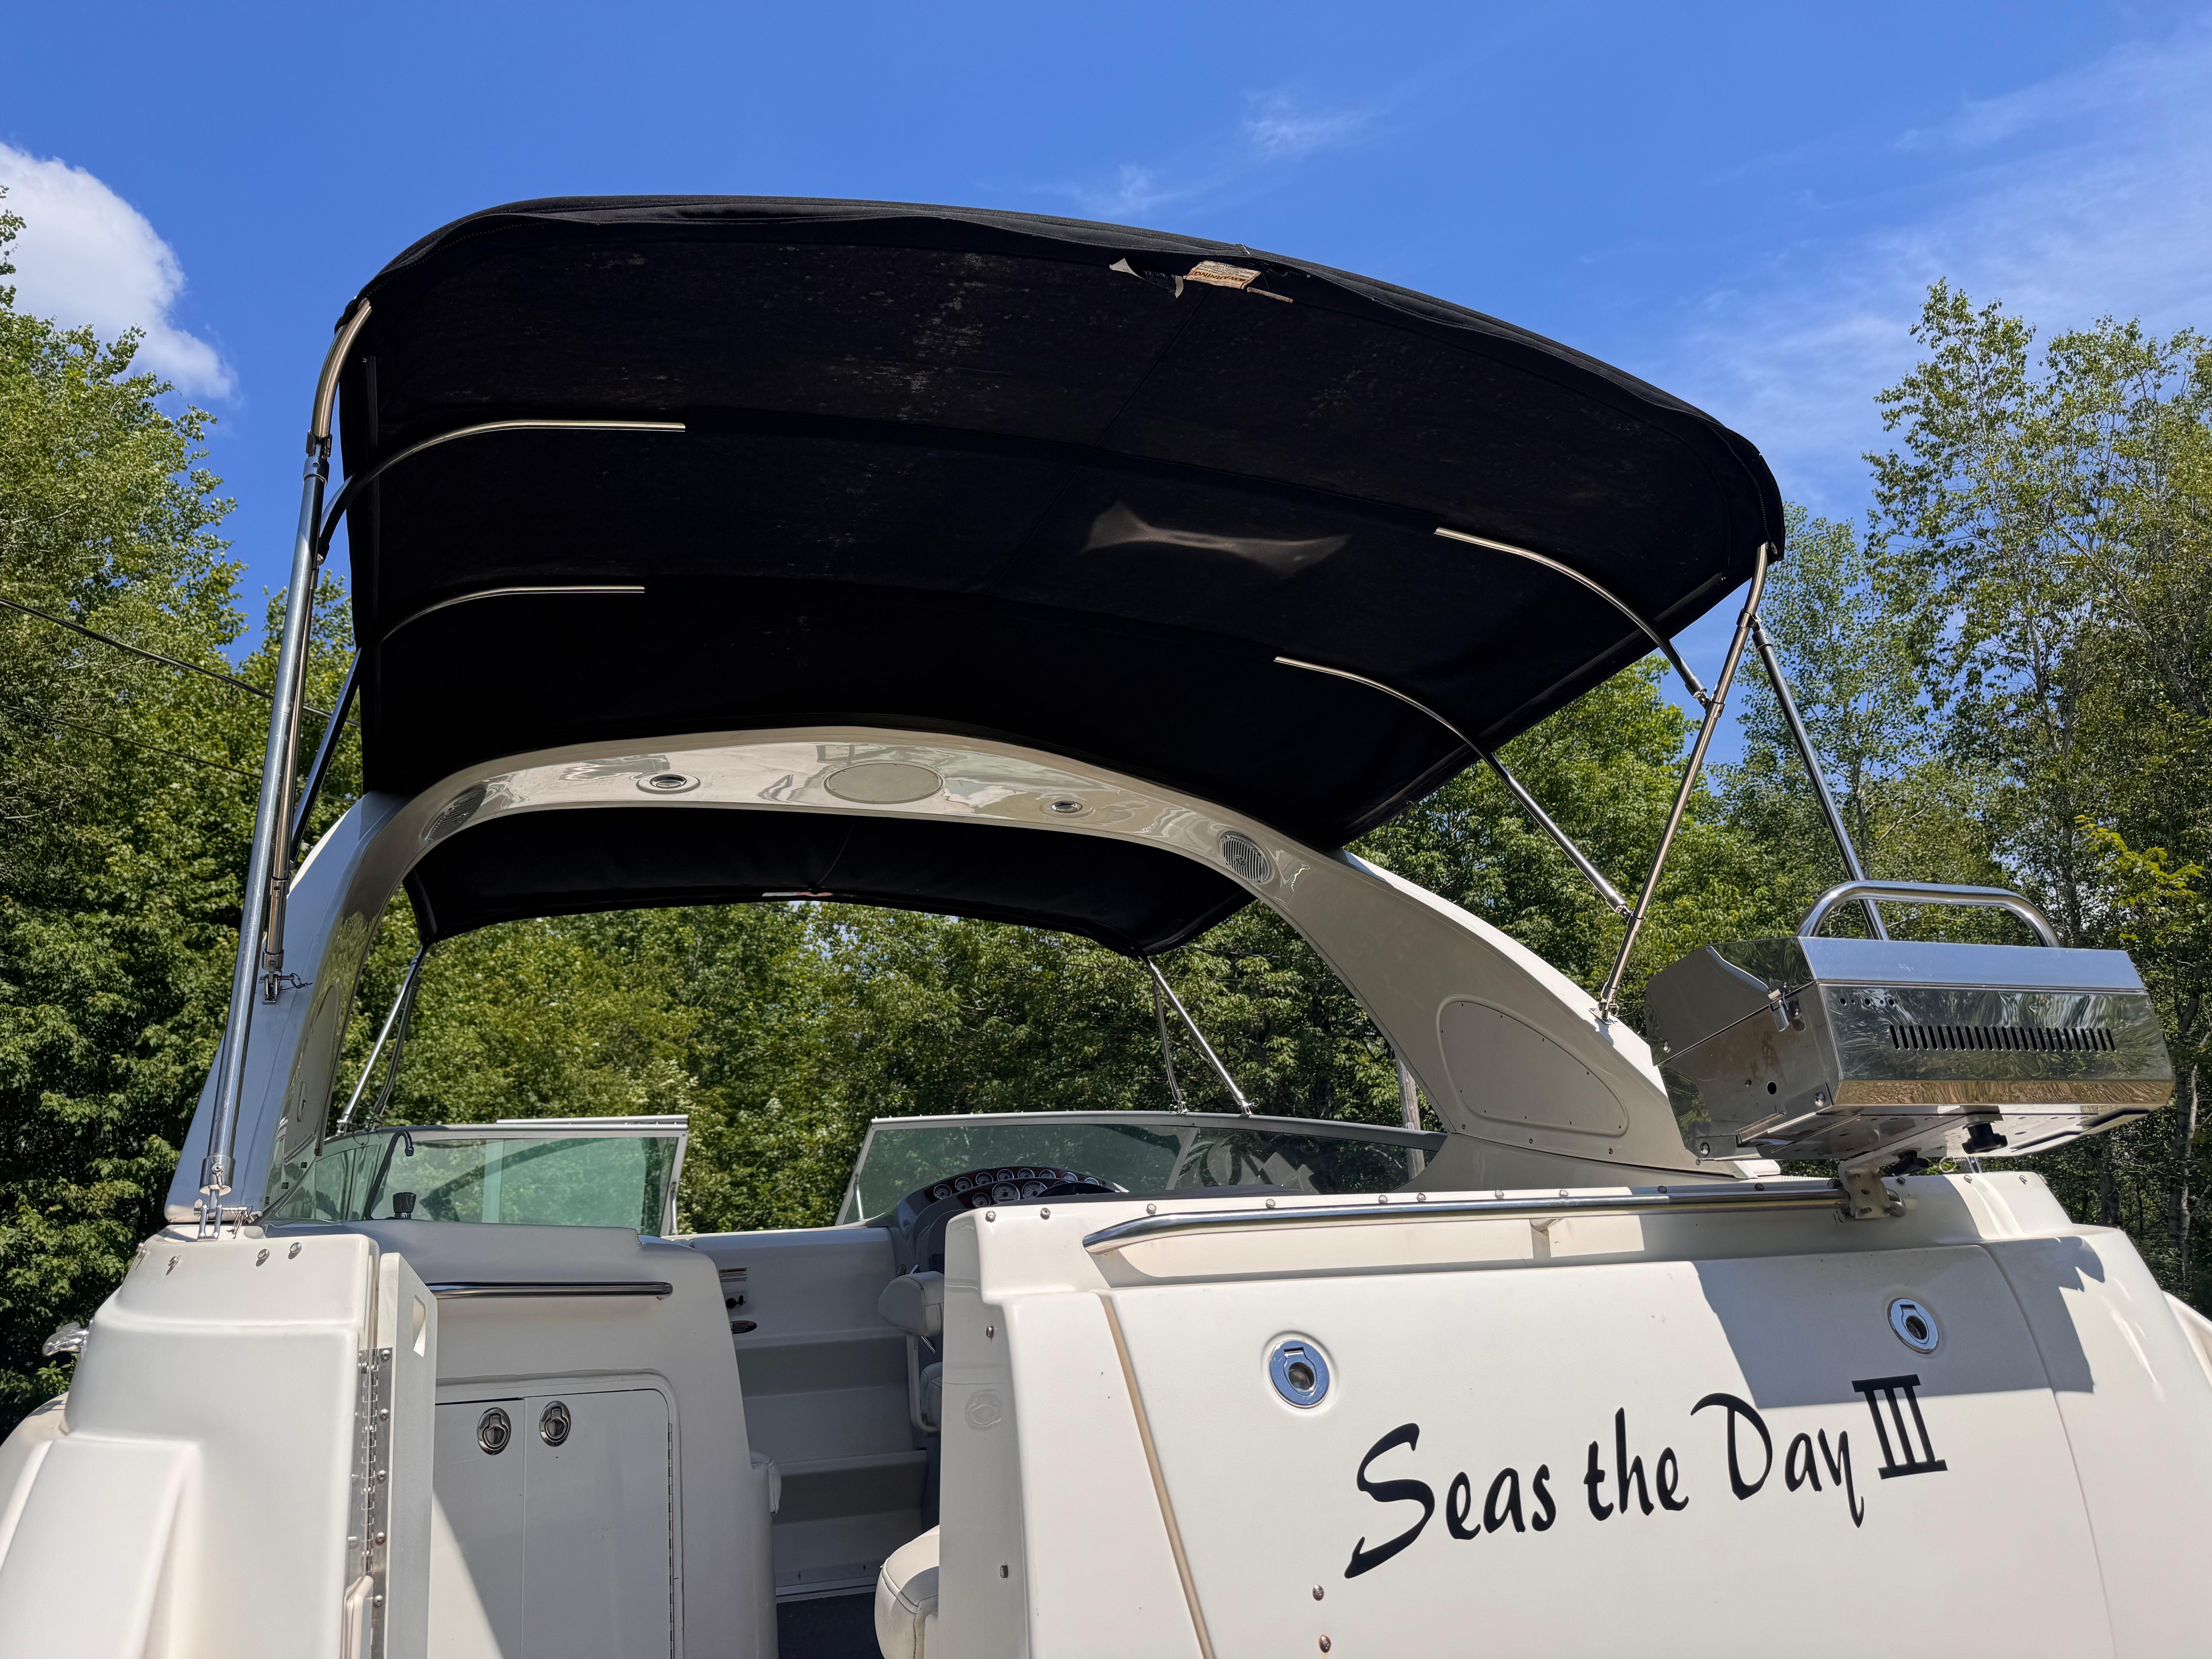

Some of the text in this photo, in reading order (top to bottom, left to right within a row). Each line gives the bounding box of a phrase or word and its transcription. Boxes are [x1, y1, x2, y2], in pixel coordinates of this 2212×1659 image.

[1195, 271, 1237, 281] WARNING
[1345, 1374, 1948, 1579] Seas the Day III
